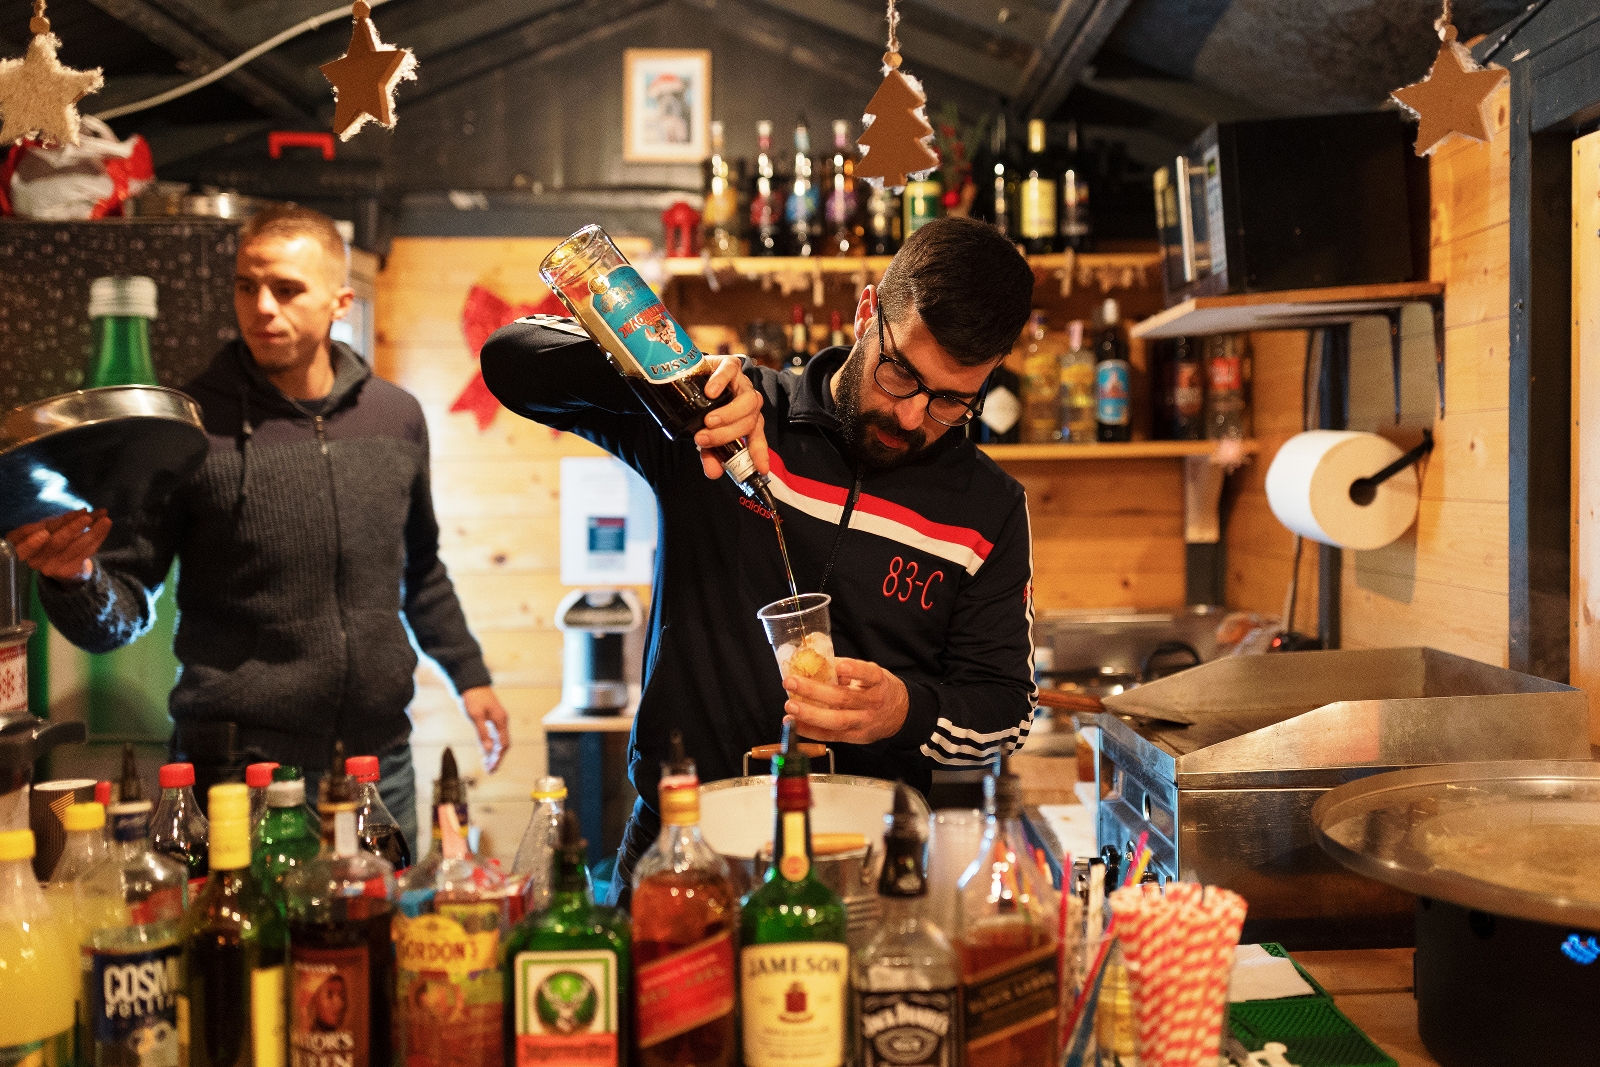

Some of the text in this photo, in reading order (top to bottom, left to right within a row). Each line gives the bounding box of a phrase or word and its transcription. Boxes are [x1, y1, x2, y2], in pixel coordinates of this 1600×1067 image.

[650, 344, 699, 376] ARASKA
[739, 496, 772, 519] adidas
[882, 556, 944, 611] 83-C
[749, 956, 840, 979] JAMESON
